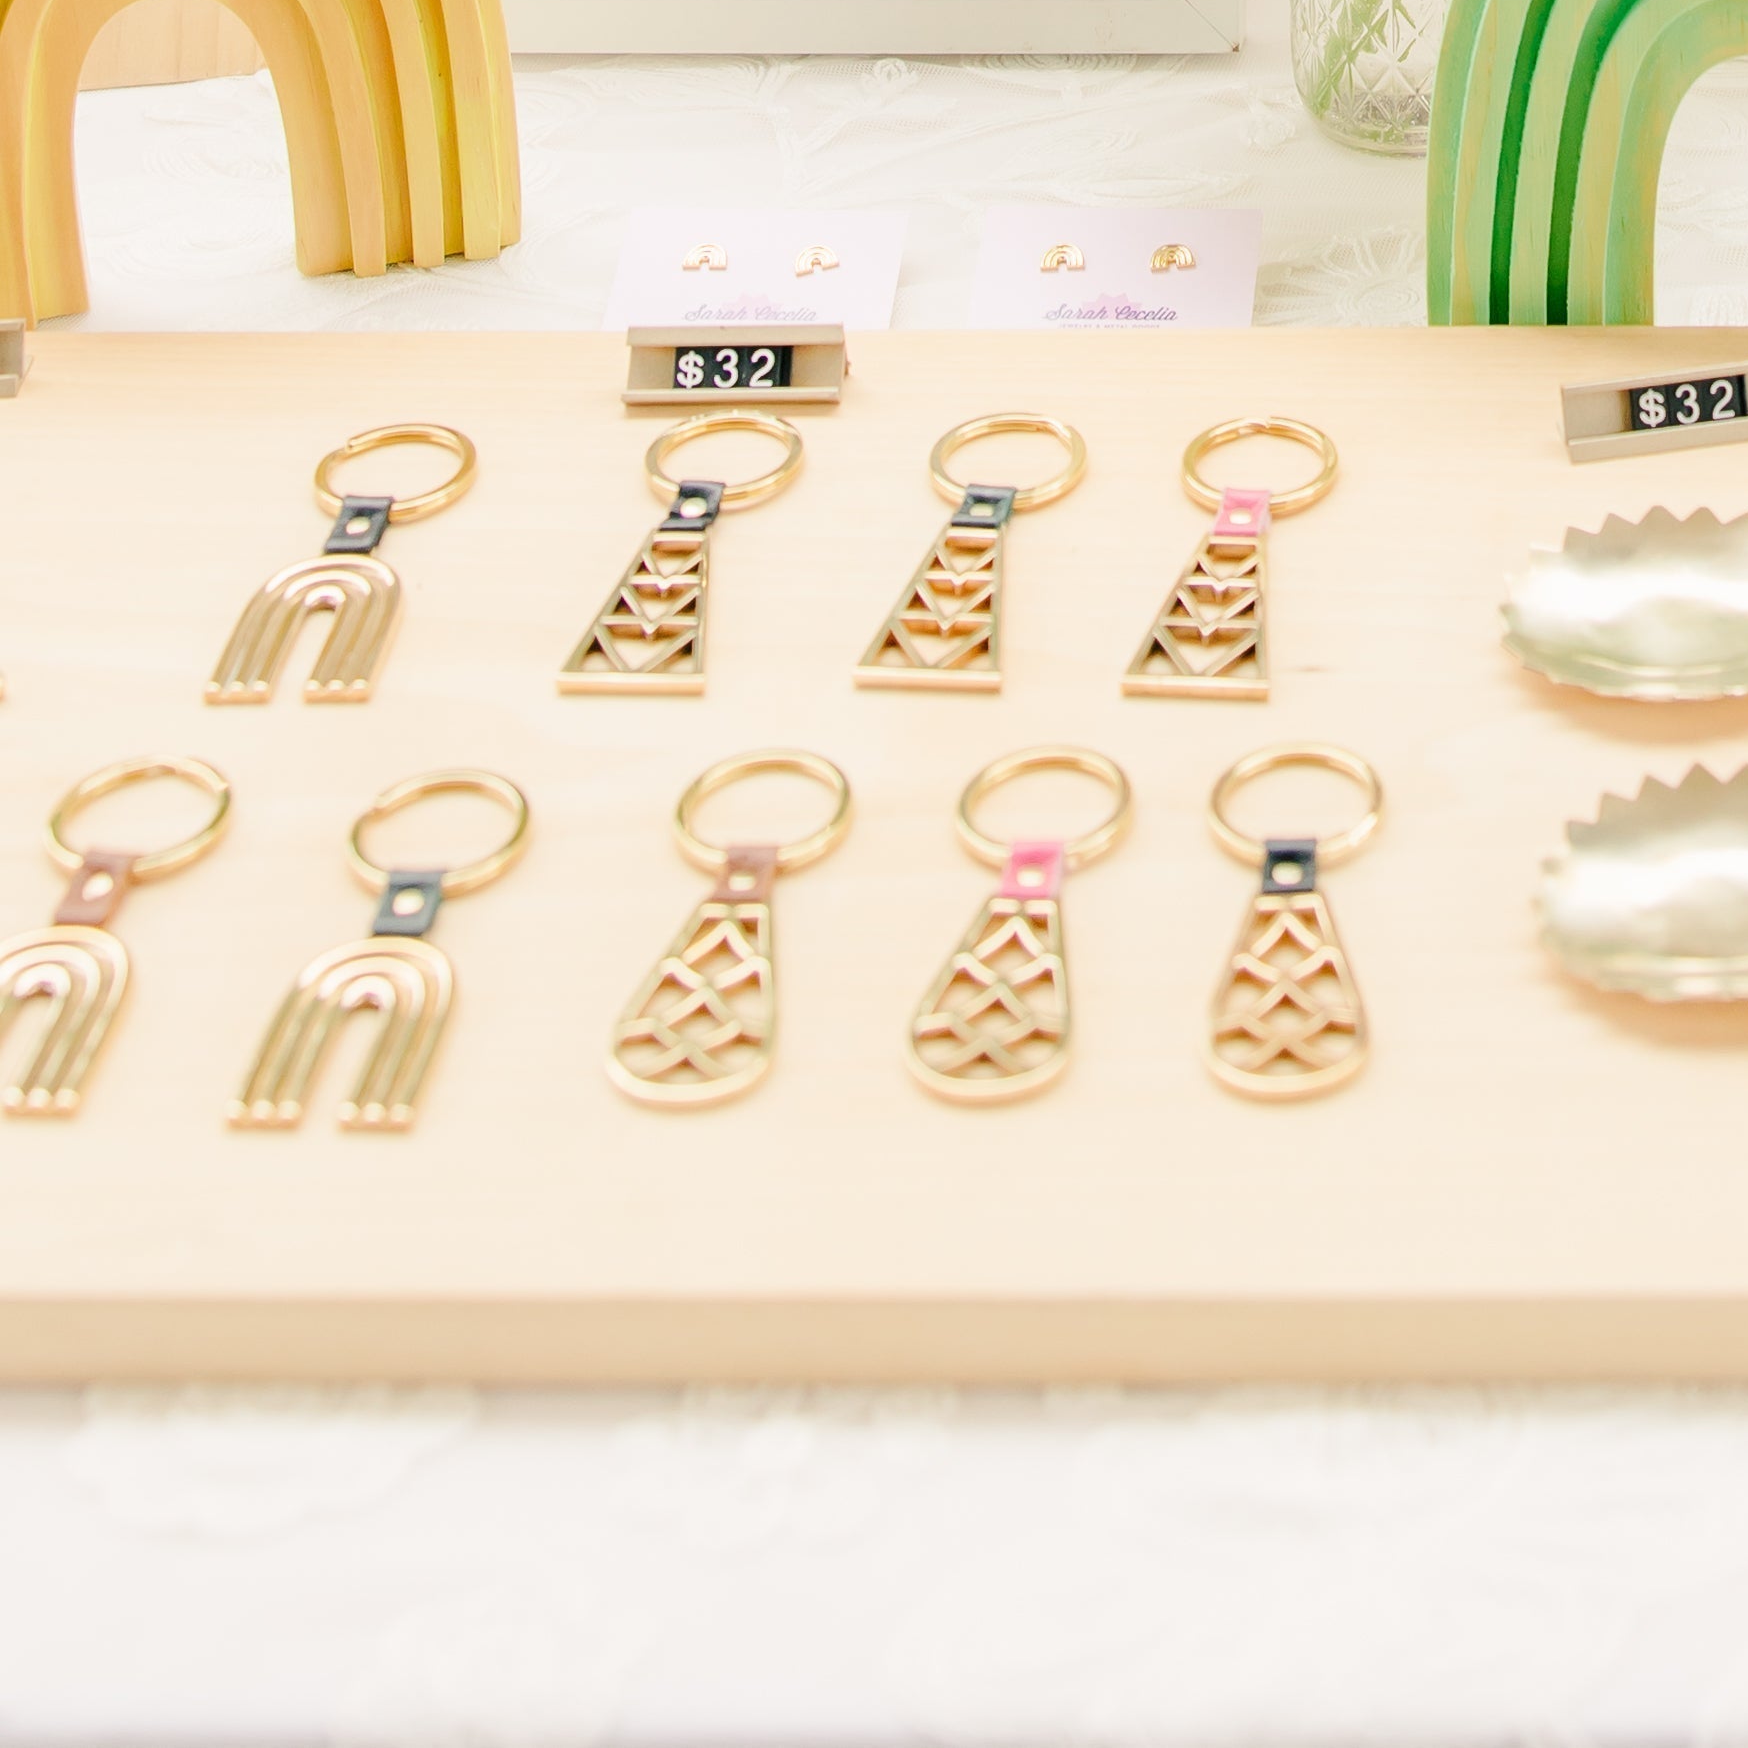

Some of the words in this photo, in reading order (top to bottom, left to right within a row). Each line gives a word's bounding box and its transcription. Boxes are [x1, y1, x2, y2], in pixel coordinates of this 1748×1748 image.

[683, 303, 748, 322] Sarah
[754, 305, 818, 322] Cecelia
[1043, 303, 1109, 321] Sarah
[1114, 305, 1178, 321] Cecelia
[676, 348, 776, 390] $32
[1638, 379, 1736, 428] $32
